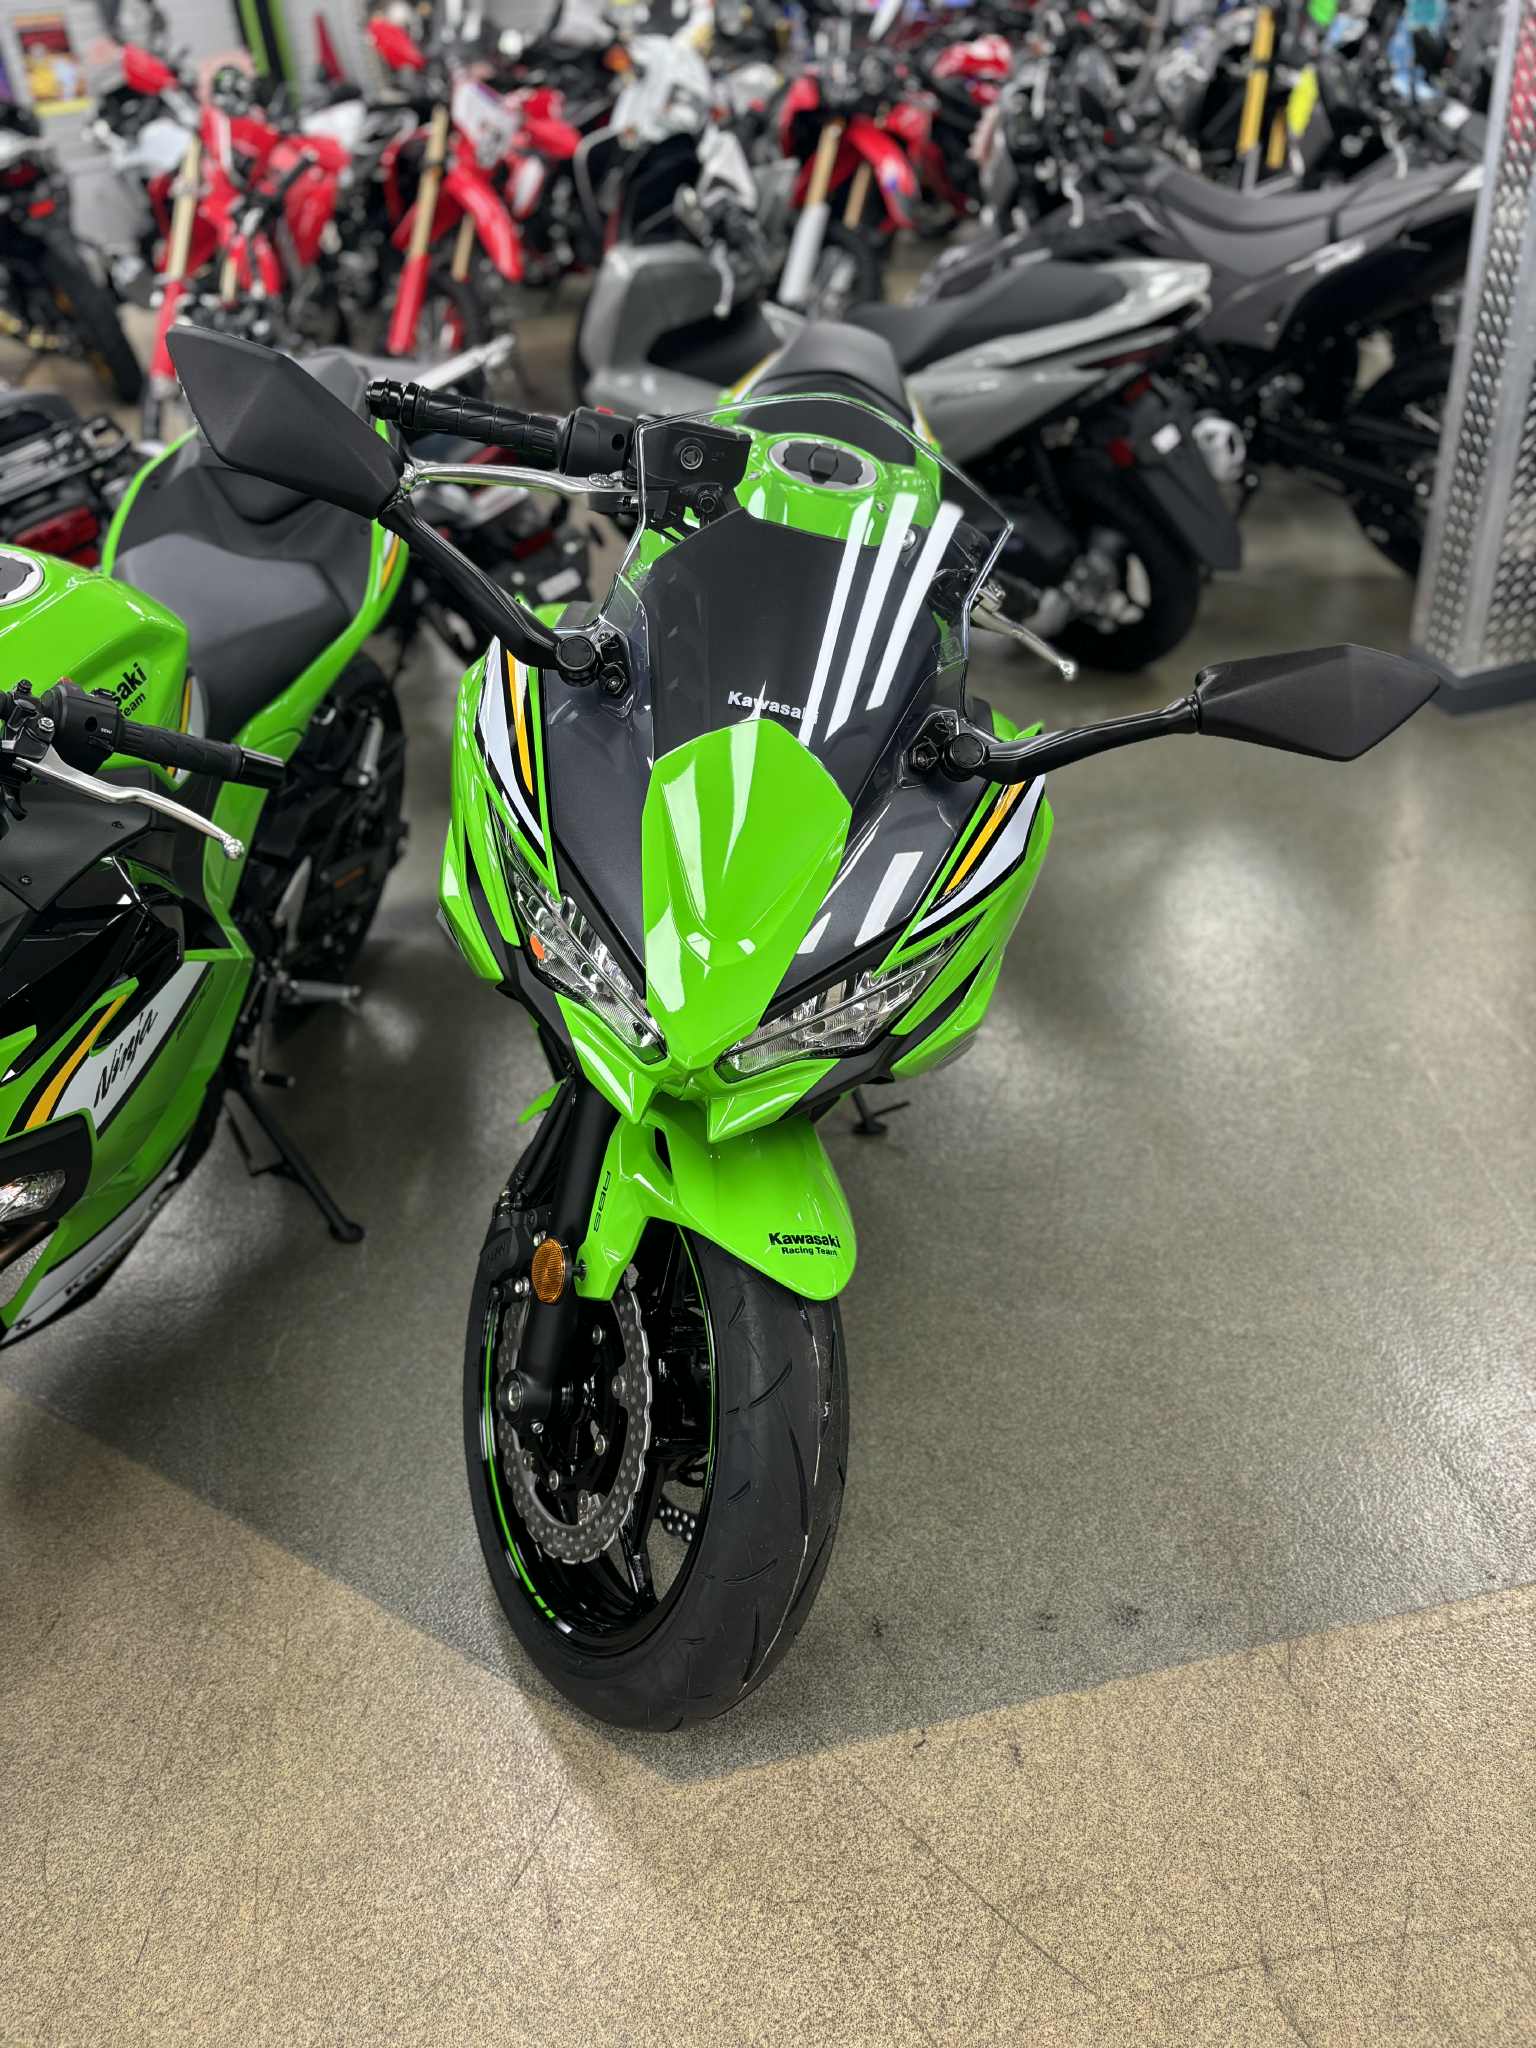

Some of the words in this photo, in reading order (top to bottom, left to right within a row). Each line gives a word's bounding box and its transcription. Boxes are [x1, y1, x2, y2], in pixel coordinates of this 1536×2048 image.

[94, 1009, 158, 1108] Ninja
[768, 1232, 841, 1248] Kawasaki
[781, 1246, 814, 1255] Racing
[815, 1246, 838, 1256] Team
